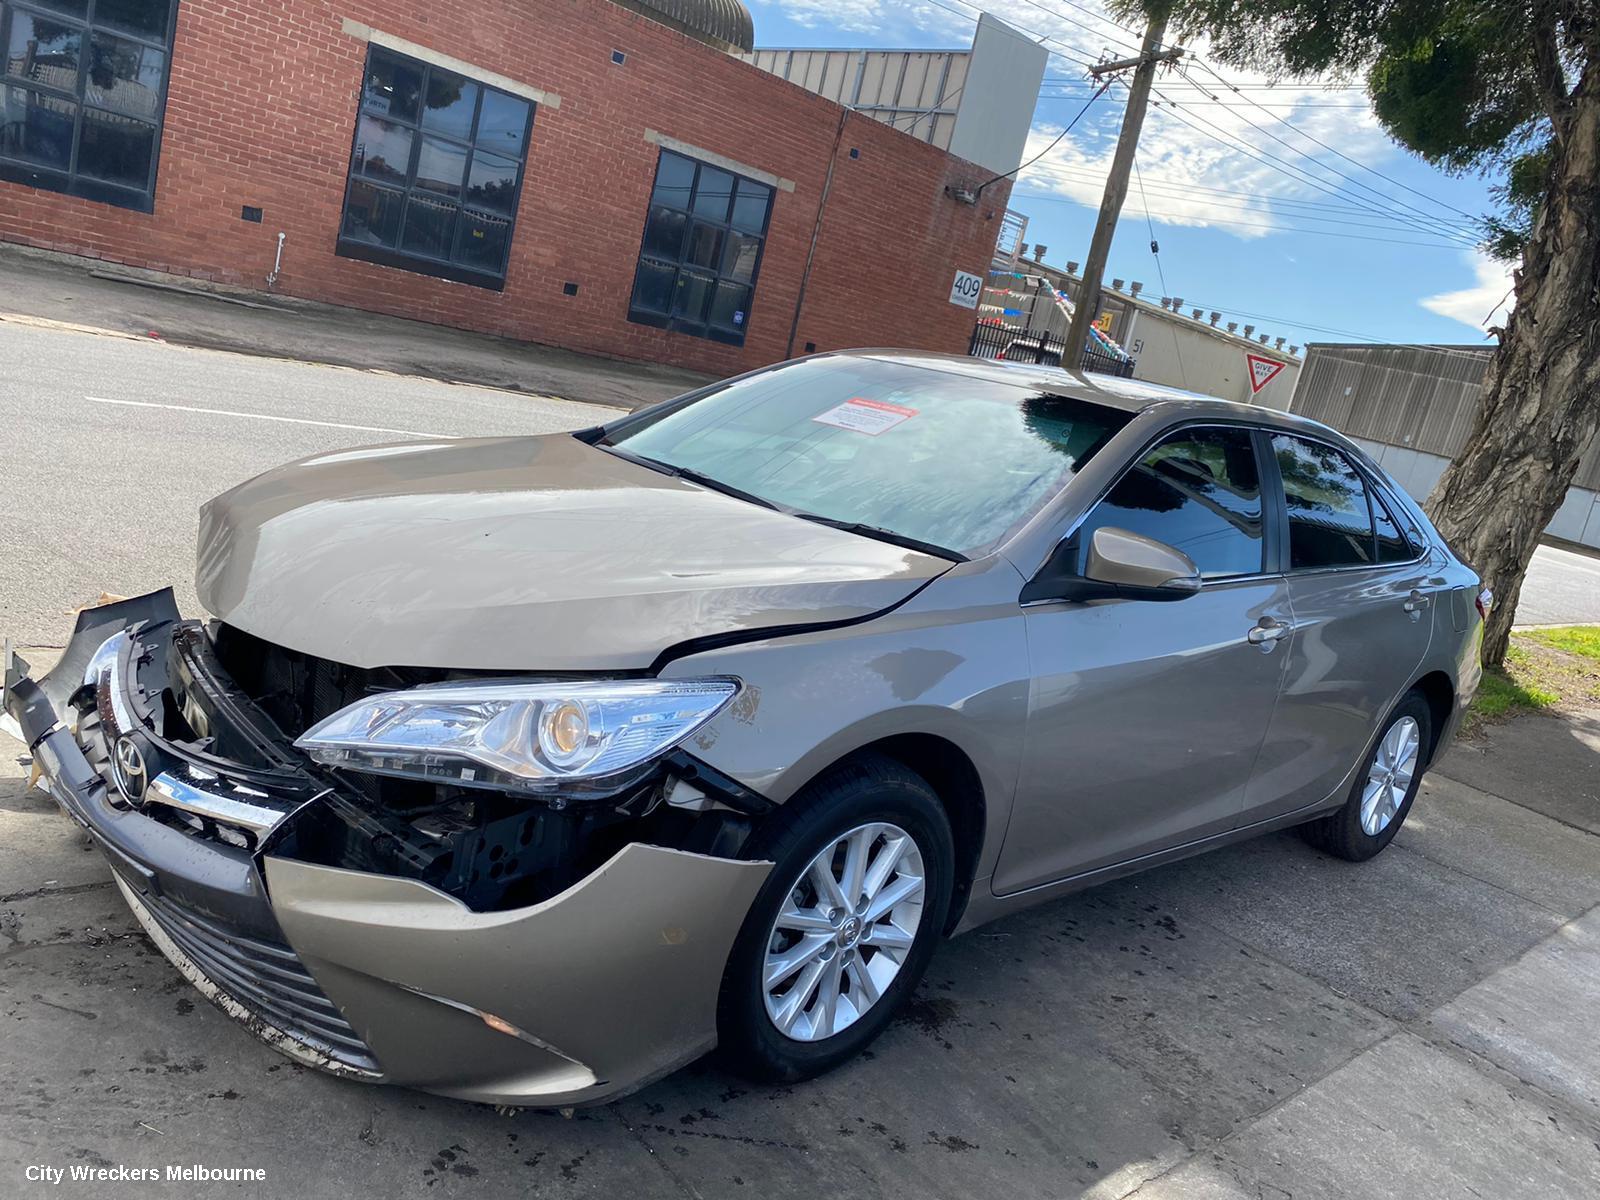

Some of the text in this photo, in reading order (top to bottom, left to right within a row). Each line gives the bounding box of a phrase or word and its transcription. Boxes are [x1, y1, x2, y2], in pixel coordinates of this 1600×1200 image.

[954, 275, 981, 298] 409
[1132, 338, 1145, 354] 51
[1255, 362, 1274, 373] GIVE
